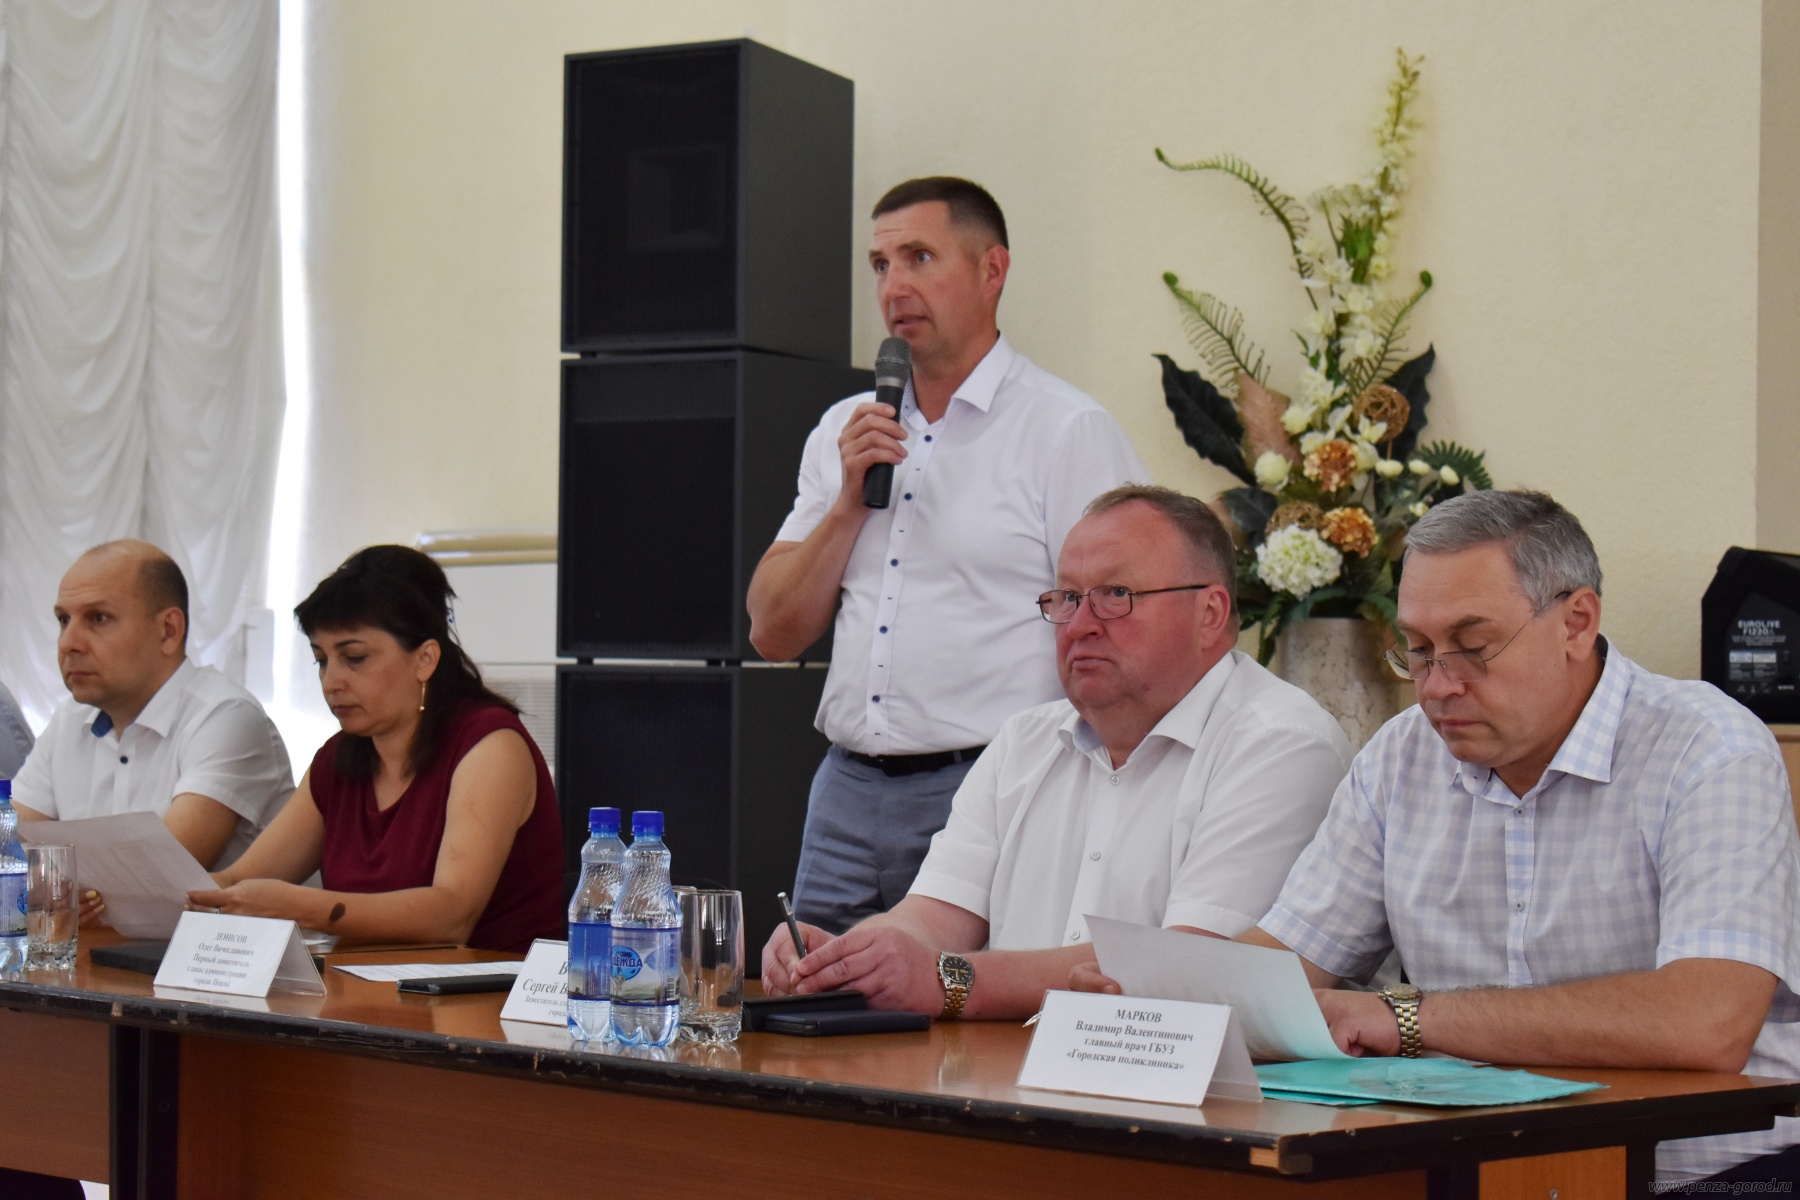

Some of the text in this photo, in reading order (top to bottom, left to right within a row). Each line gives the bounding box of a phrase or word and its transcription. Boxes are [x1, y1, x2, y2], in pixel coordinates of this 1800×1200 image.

[1738, 620, 1780, 628] EUROLIVE
[213, 932, 248, 943] ДЕНИСОВ
[198, 942, 213, 951] Олег
[192, 953, 217, 964] Первый
[522, 979, 560, 995] Сергей
[1115, 1009, 1163, 1023] МАРКОВ
[1076, 1020, 1194, 1042] Владимир Валентинович
[1084, 1038, 1175, 1055] главный врач ГБУЗ
[1067, 1049, 1185, 1070] «Городская поликлиника»
